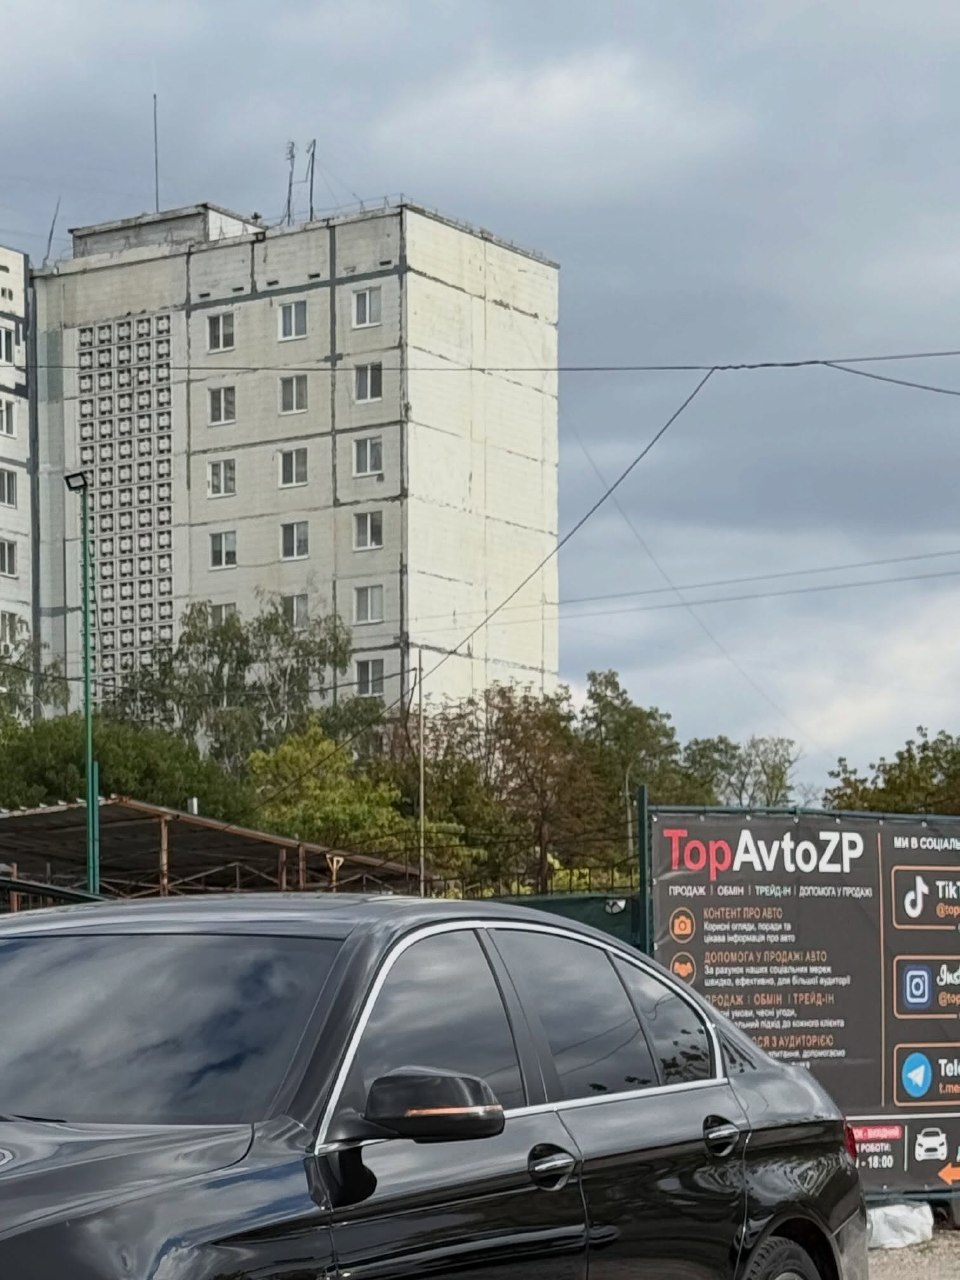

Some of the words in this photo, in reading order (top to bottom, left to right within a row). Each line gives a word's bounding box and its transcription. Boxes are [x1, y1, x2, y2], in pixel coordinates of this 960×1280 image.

[894, 836, 909, 849] МИ
[911, 836, 918, 849] В
[663, 829, 864, 882] TopAvtoZP
[668, 885, 706, 897] ПРОДАЖ
[717, 885, 744, 896] ОБМІН
[754, 883, 791, 898] ТРЕЙД-ІН
[798, 886, 836, 898] ДОПОМОГА
[704, 907, 740, 919] КОНТЕНТ
[743, 907, 761, 919] ПРО
[762, 907, 783, 919] АВТО
[704, 951, 754, 963] ДОПОМОГА
[755, 951, 762, 962] У
[763, 951, 803, 963] ПРОДАЖІ
[805, 951, 827, 962] АВТО
[754, 993, 783, 1005] ОБМІН
[793, 991, 834, 1006] ТРЕЙД-ІН
[779, 1034, 834, 1048] АУДИТОРІЄЮ
[868, 1154, 894, 1168] 18:00
